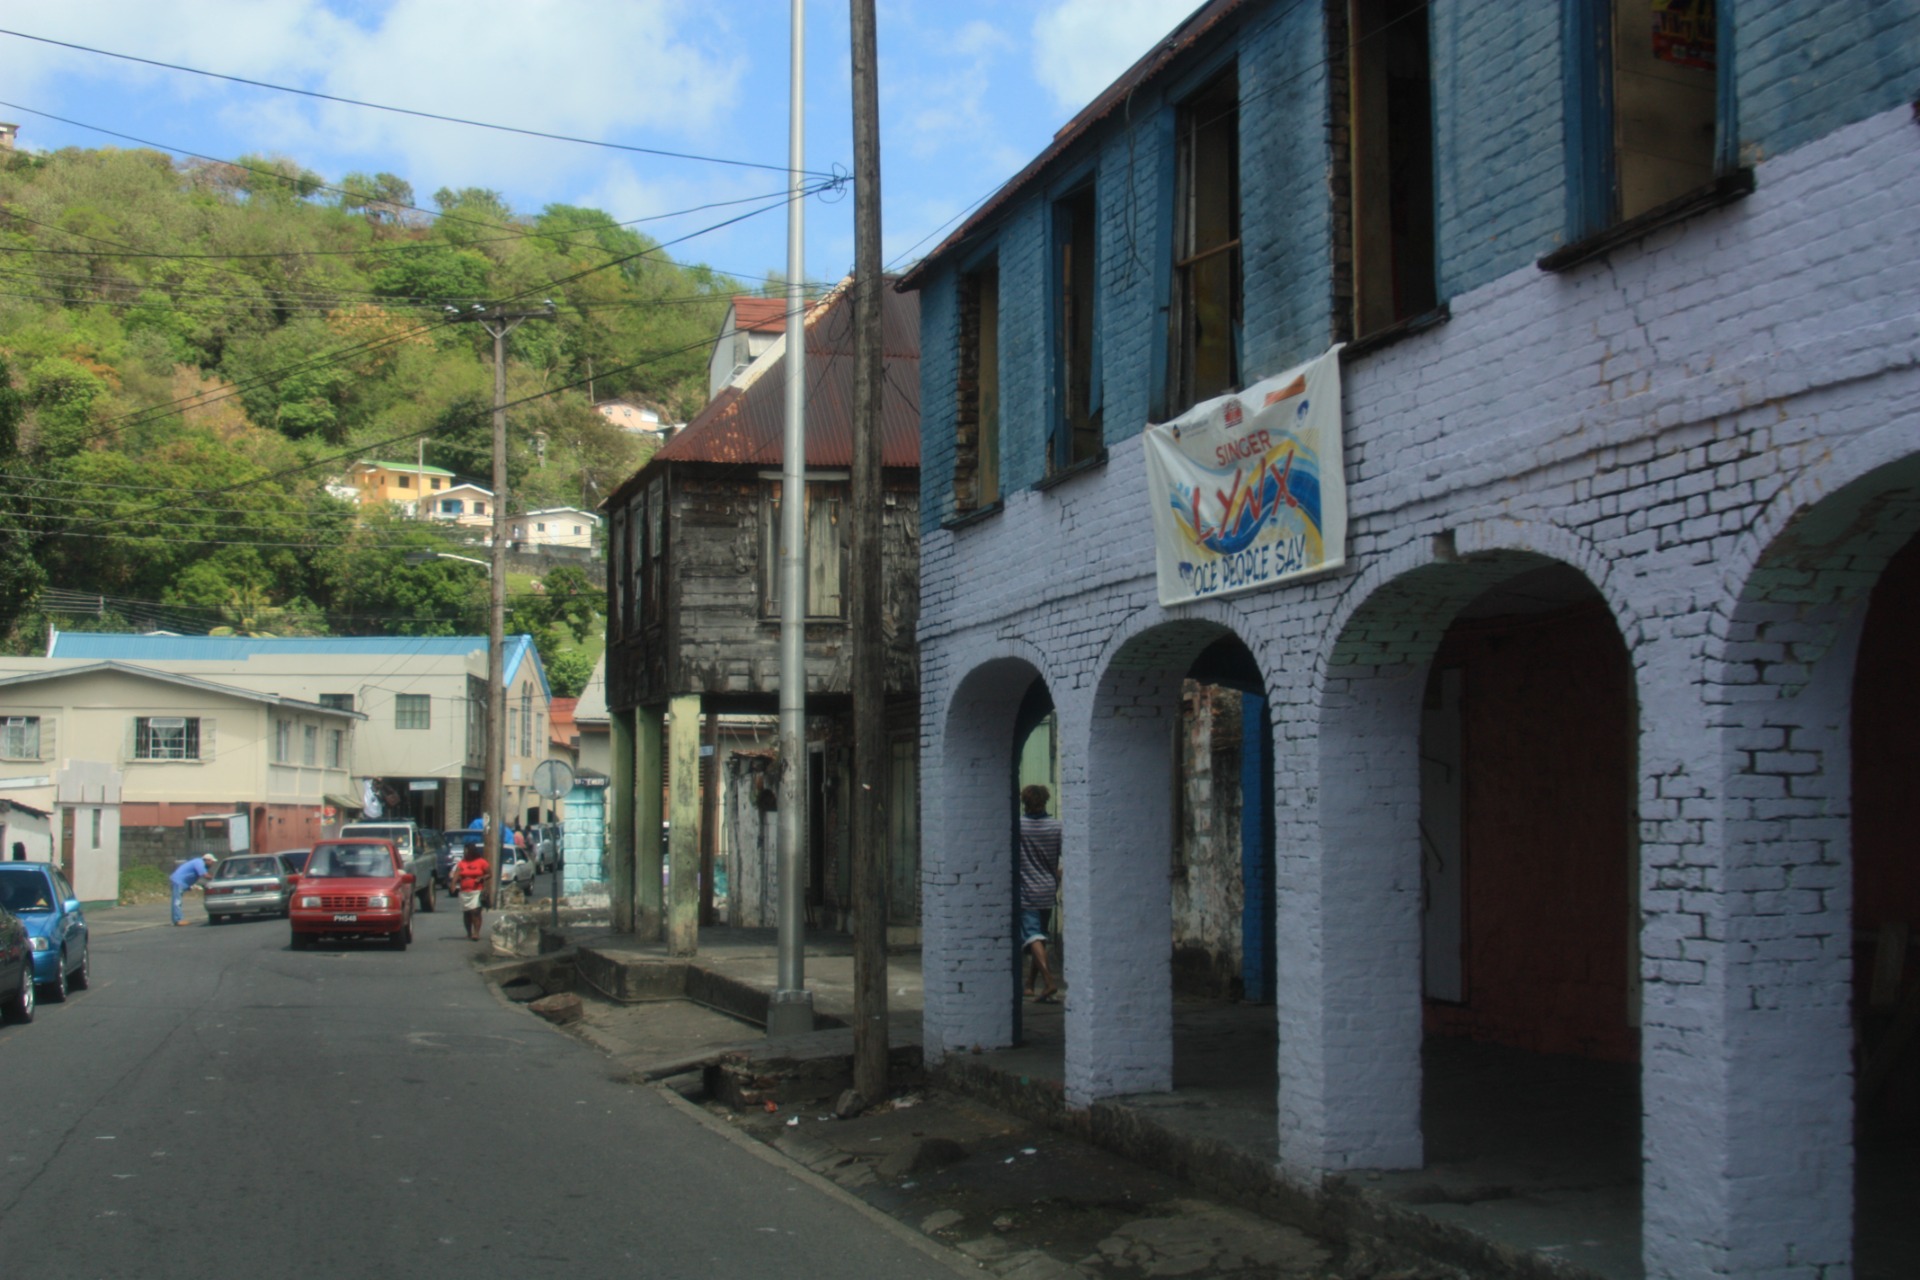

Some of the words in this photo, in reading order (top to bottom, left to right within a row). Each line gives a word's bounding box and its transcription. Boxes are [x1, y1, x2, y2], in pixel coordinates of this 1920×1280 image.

[1216, 429, 1272, 466] SINGER
[1192, 449, 1298, 545] LYNX
[1222, 544, 1270, 590] PEOPLE
[1275, 533, 1306, 576] SAY
